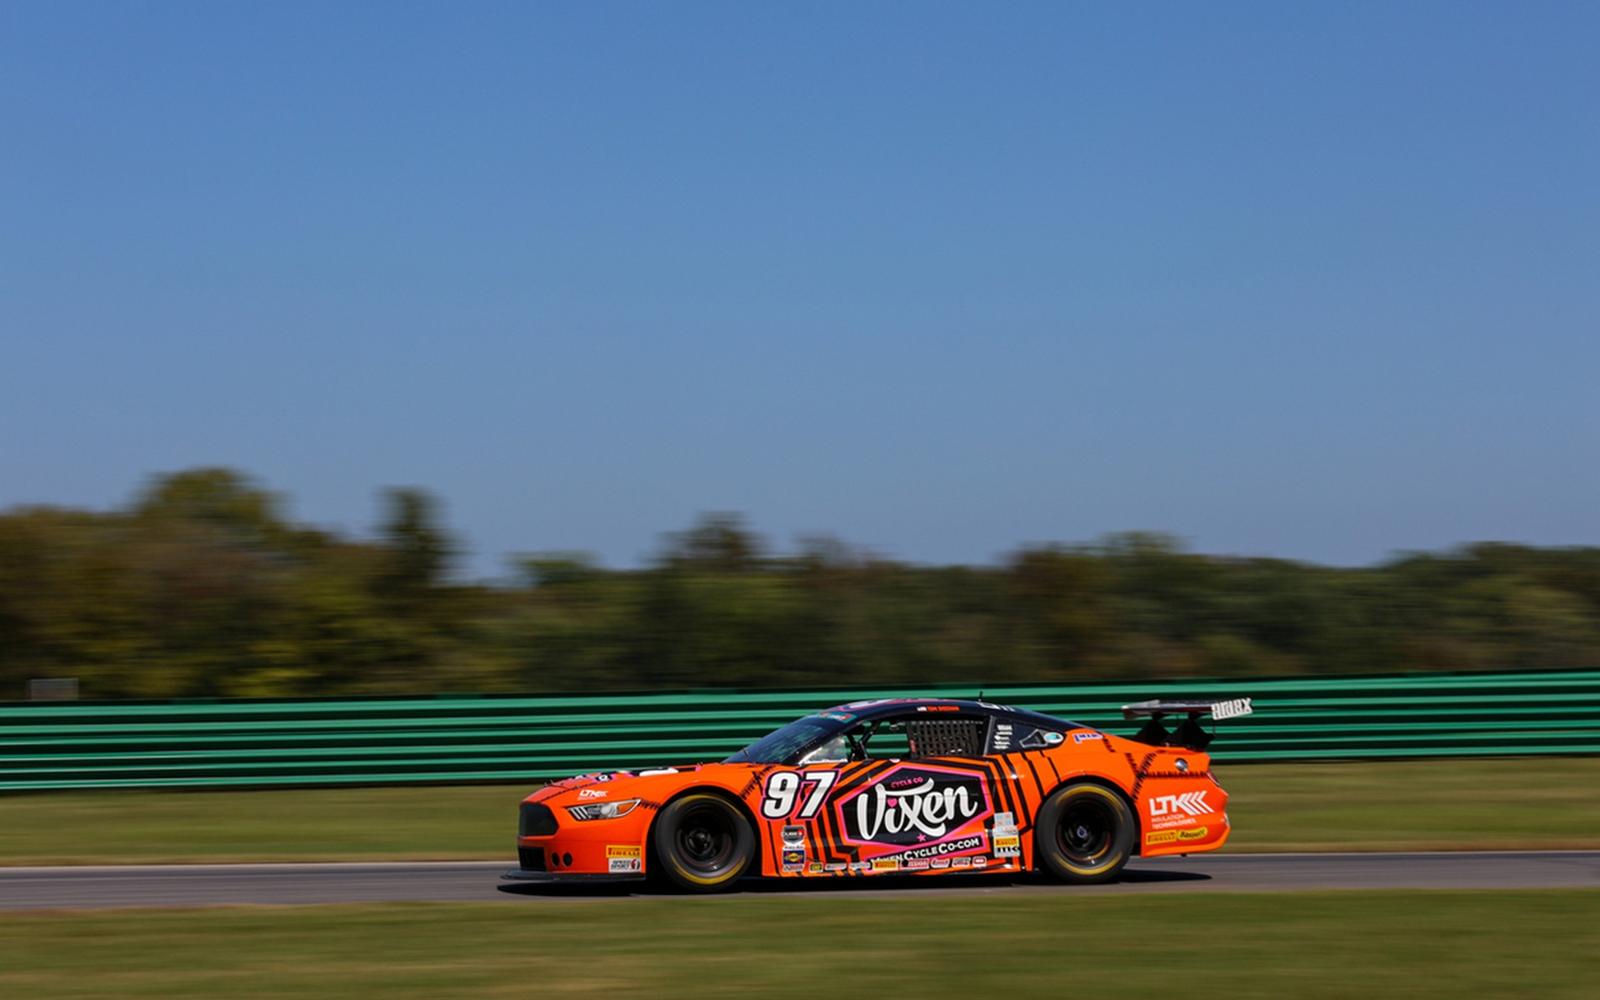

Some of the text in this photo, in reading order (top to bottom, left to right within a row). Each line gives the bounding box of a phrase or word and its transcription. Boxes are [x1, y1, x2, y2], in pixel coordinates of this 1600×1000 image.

[890, 776, 924, 788] CYCLE CO
[762, 771, 837, 818] 97
[1149, 791, 1206, 816] LTK
[857, 777, 978, 840] Vixen
[1147, 832, 1175, 842] PIRELLI
[608, 847, 640, 856] PIRELLI
